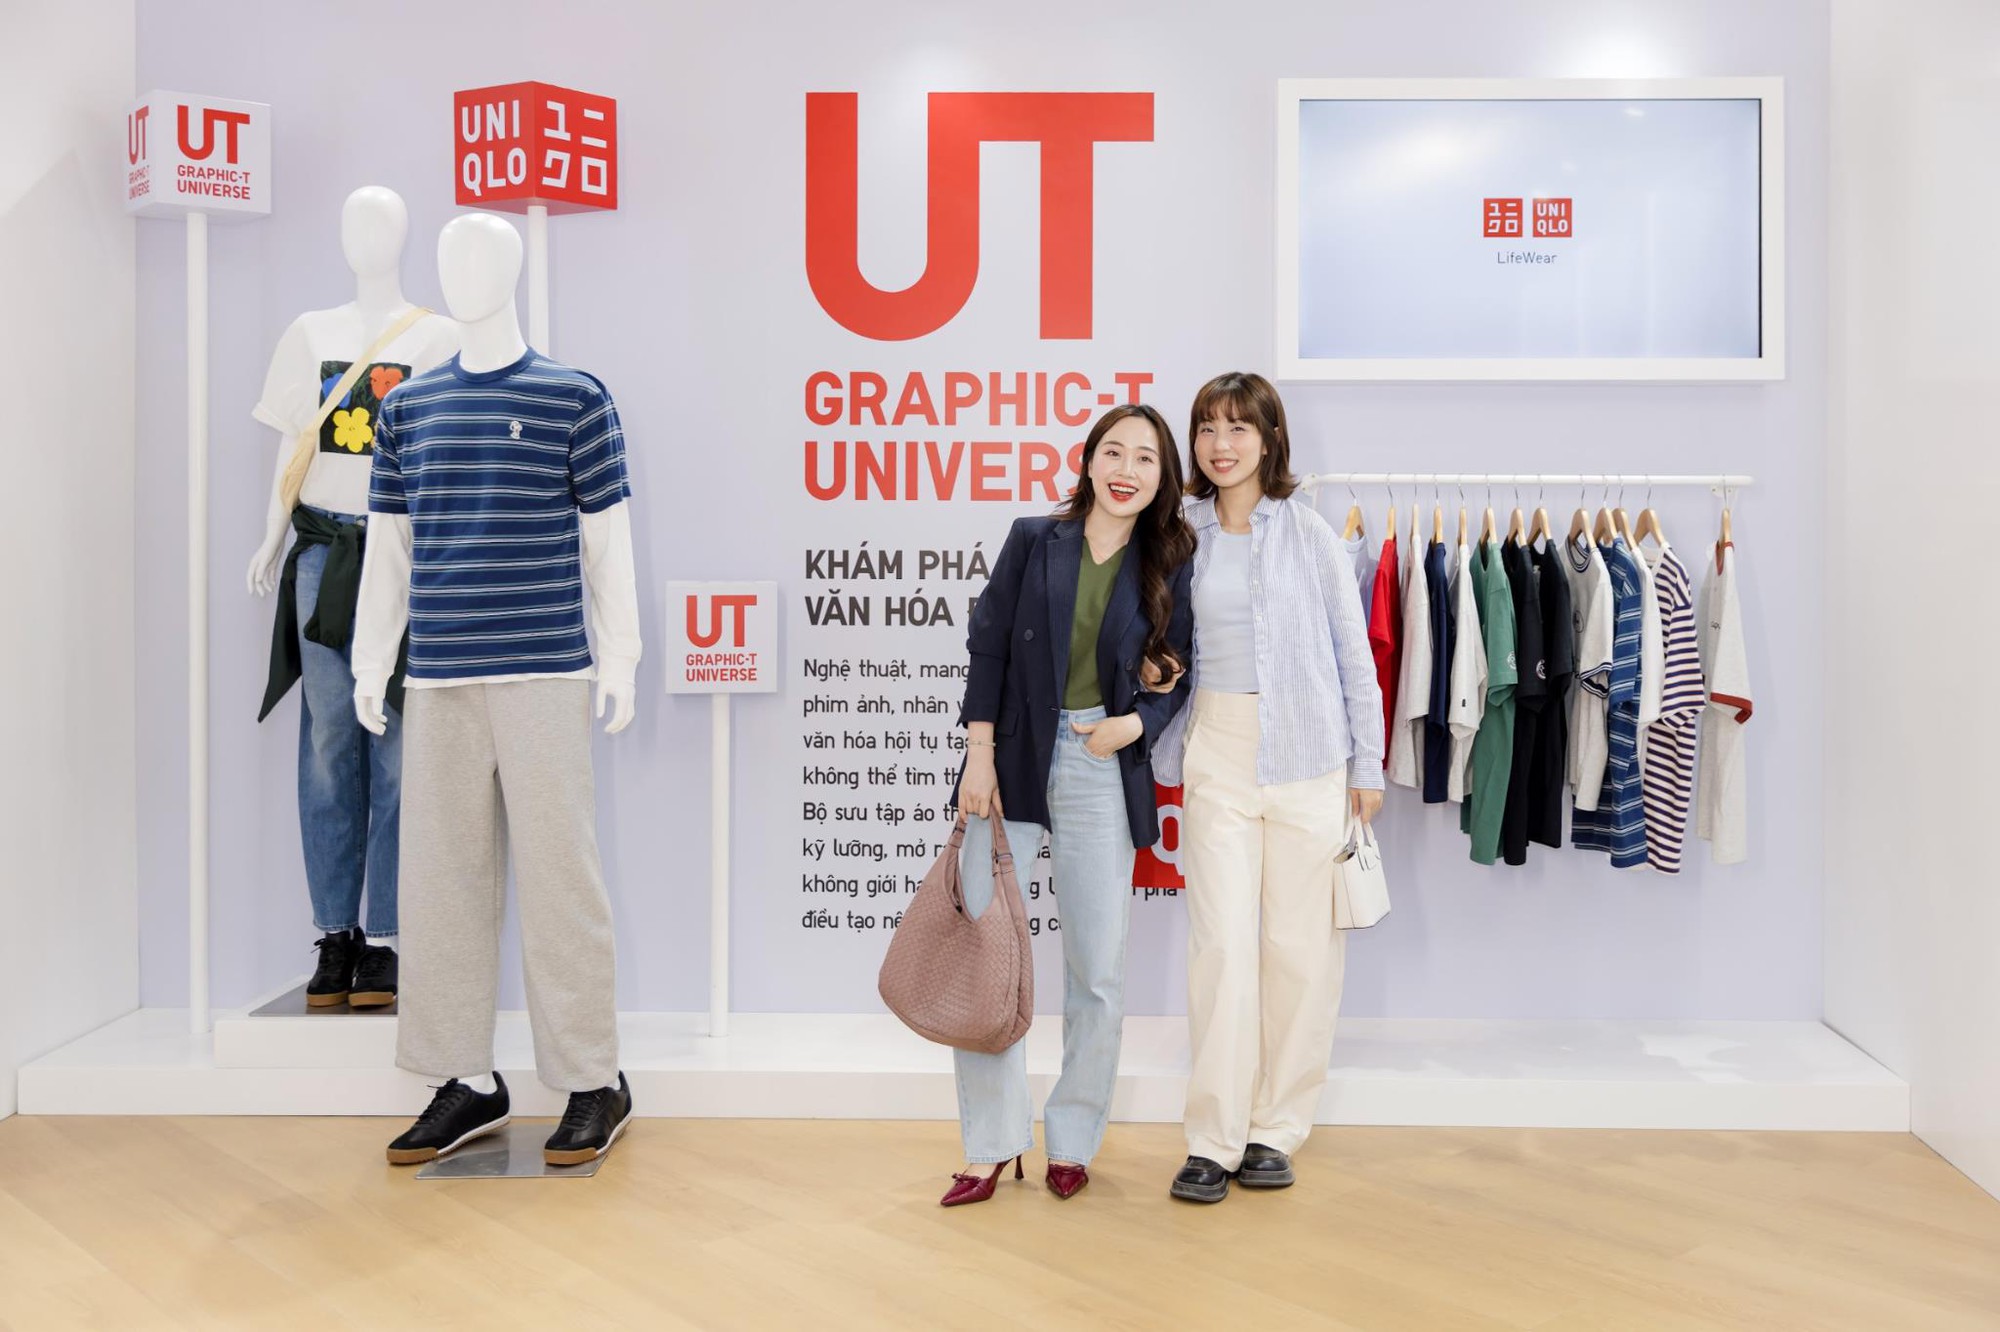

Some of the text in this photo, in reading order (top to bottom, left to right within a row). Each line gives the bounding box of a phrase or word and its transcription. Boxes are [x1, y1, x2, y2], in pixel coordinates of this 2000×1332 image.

[462, 99, 520, 144] UNI
[128, 105, 149, 165] UT
[177, 104, 251, 165] UT
[177, 164, 251, 184] GRAPHIC-T
[463, 147, 527, 197] QLO
[177, 179, 251, 200] UNIVERSE
[805, 92, 1155, 342] UT
[1537, 203, 1565, 217] UNI
[1537, 219, 1568, 235] QLO
[1497, 251, 1557, 264] LifeWear
[804, 371, 1154, 426] GRAPHIC-T
[804, 441, 1083, 501] UNIVER
[805, 541, 991, 580] KHÁM PHÁ
[805, 588, 870, 626] VĂN
[885, 588, 954, 627] HÓA
[686, 594, 757, 648] UT
[686, 653, 757, 666] GRAPHIC-T
[803, 659, 851, 682] Nghệ
[858, 659, 912, 682] thuật,
[686, 668, 757, 682] UNIVERSE
[803, 694, 849, 717] phim
[857, 694, 895, 715] ảnh,
[903, 695, 948, 714] nhân
[803, 731, 835, 749] văn
[843, 730, 877, 749] hóa
[885, 731, 911, 754] hội
[919, 731, 938, 754] tụ
[803, 766, 859, 790] không
[867, 763, 898, 785] thể
[905, 766, 936, 785] tìm
[803, 802, 828, 825] Bộ
[835, 806, 868, 821] sưu
[875, 803, 905, 826] tập
[913, 803, 935, 821] áo
[802, 838, 826, 861] kỹ
[833, 838, 889, 862] lưỡng,
[896, 838, 926, 858] mở
[802, 874, 859, 898] không
[866, 875, 897, 898] giới
[801, 908, 840, 929] điều
[847, 910, 876, 933] tạo
